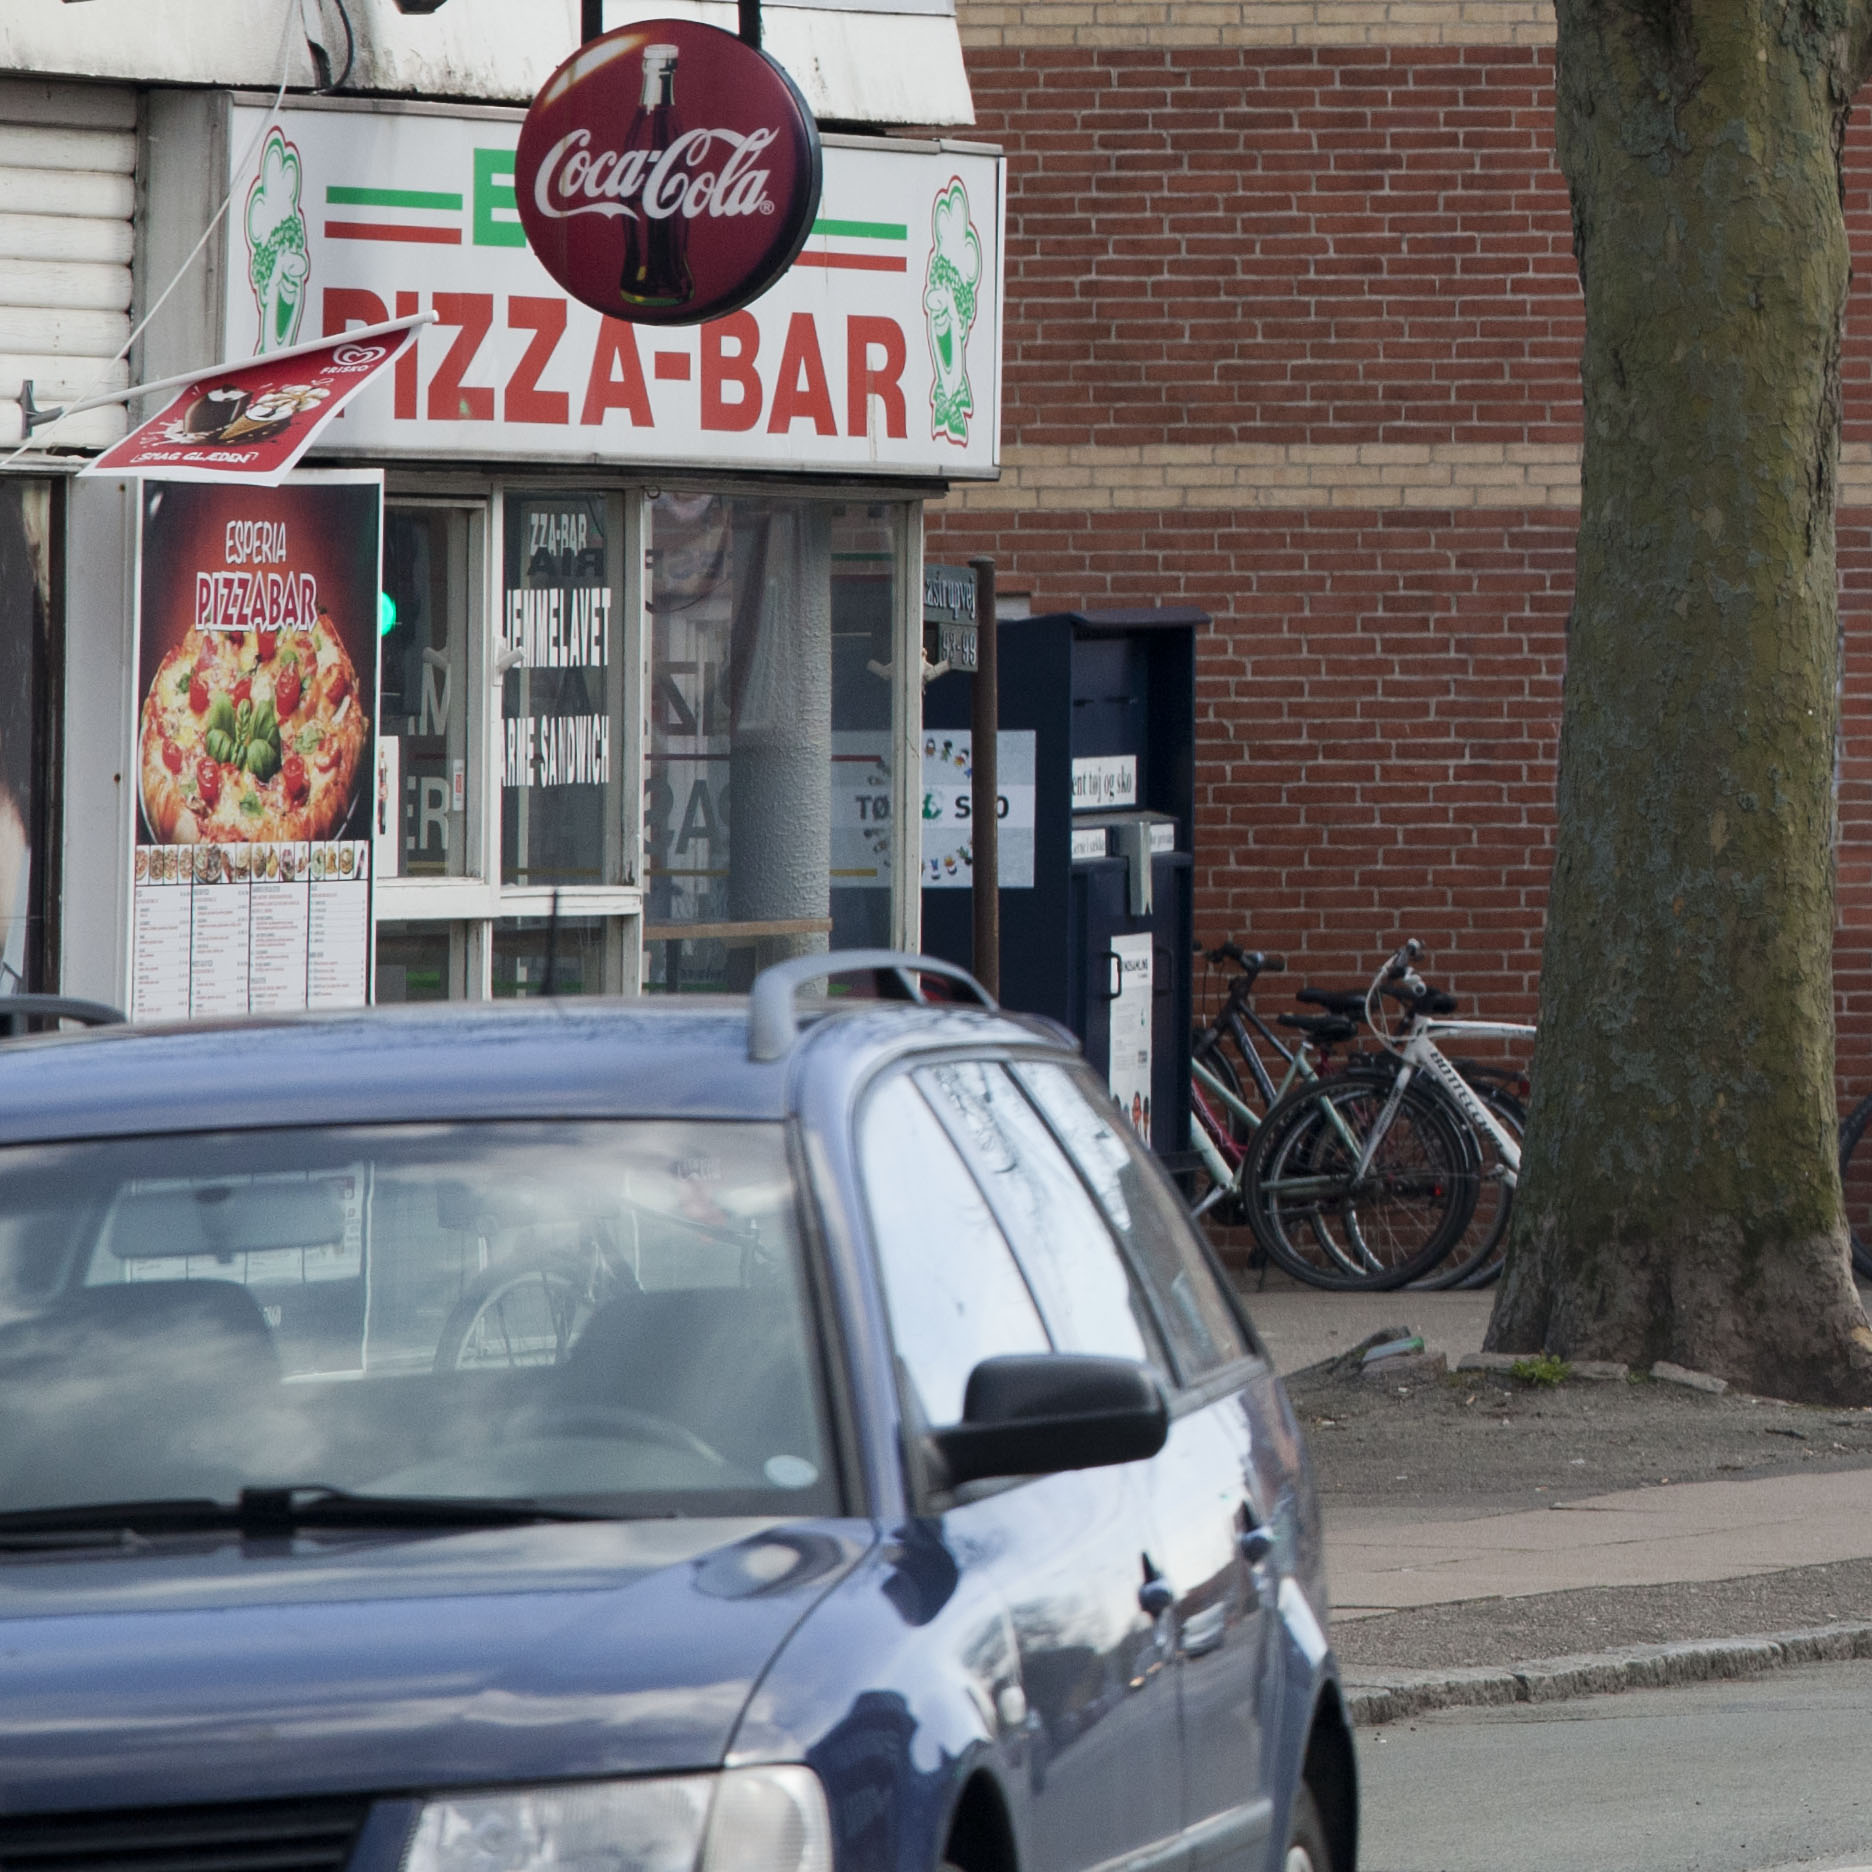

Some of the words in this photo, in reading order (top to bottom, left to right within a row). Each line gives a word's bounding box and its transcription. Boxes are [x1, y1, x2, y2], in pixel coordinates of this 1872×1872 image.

[534, 127, 780, 221] Coca-Cola
[320, 364, 370, 375] FRISKO
[138, 451, 180, 462] SMAG
[182, 451, 250, 464] GLÆDEN
[225, 520, 287, 564] ESPERIA
[530, 512, 588, 557] ZZA-BAR
[195, 570, 318, 632] PIZZABAR
[923, 573, 976, 620] astrupvej
[503, 587, 611, 668] JEMMELAVET
[500, 716, 535, 788] ARME
[540, 713, 610, 788] SANDWICH
[1072, 771, 1086, 797] ent
[855, 795, 891, 821] TØ
